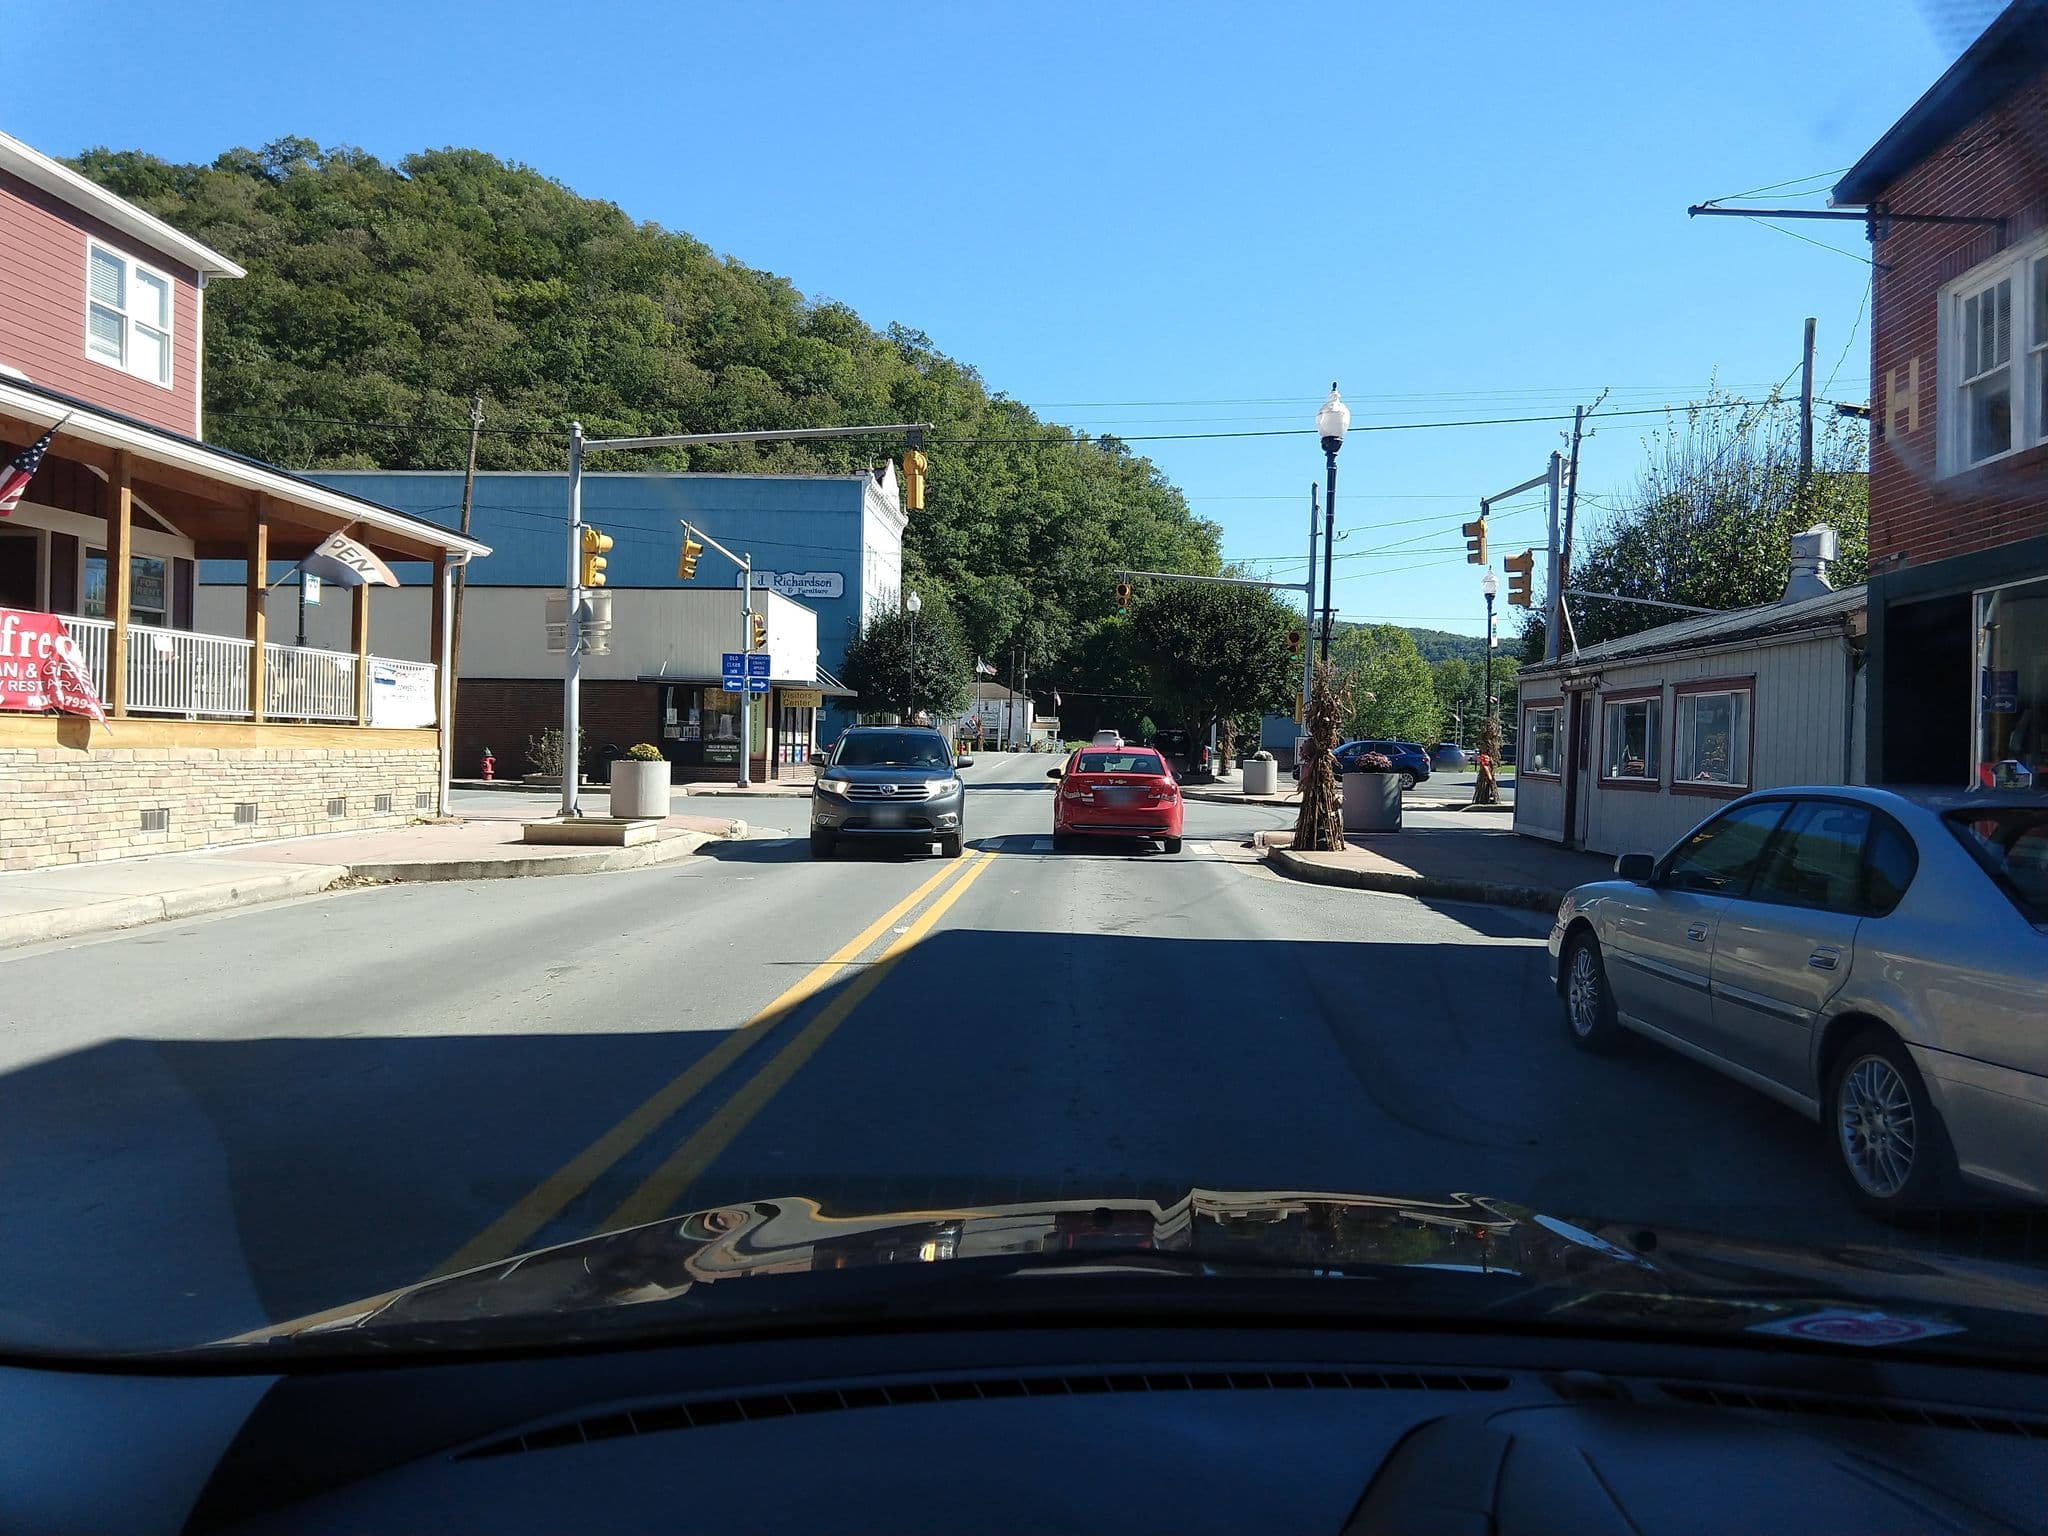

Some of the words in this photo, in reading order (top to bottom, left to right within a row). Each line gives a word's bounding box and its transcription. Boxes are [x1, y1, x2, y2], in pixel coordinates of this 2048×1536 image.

[1885, 357, 1920, 442] H
[331, 539, 376, 572] PEN
[773, 575, 832, 588] Richardson
[26, 662, 38, 678] &
[782, 691, 812, 699] Visitors
